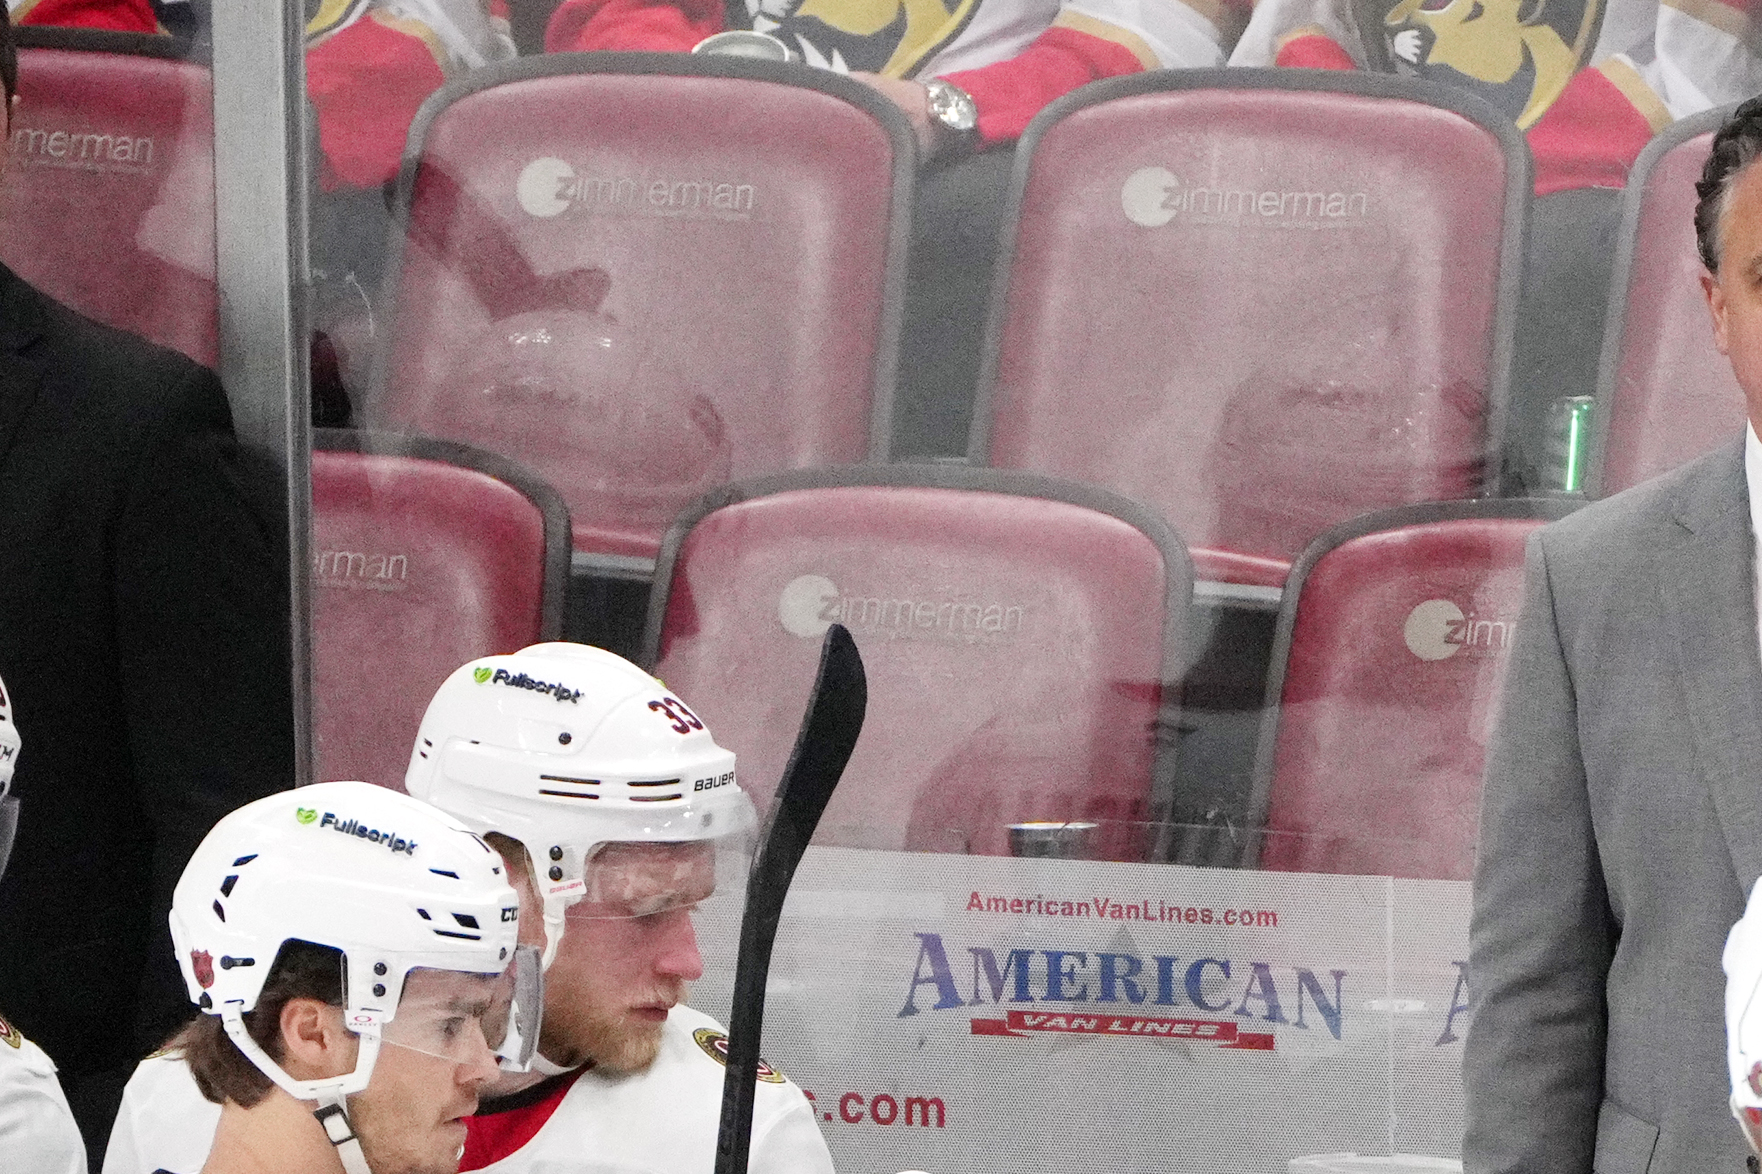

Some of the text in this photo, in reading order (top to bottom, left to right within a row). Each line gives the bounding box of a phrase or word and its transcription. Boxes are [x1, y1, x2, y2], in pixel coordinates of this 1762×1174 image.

[492, 667, 584, 704] Fullscript
[648, 697, 704, 735] 33
[320, 811, 418, 856] Fullscript
[966, 890, 1279, 928] AmericanVanLines.com
[897, 932, 1348, 1041] AMERICAN
[1022, 1013, 1219, 1037] VAN LINES
